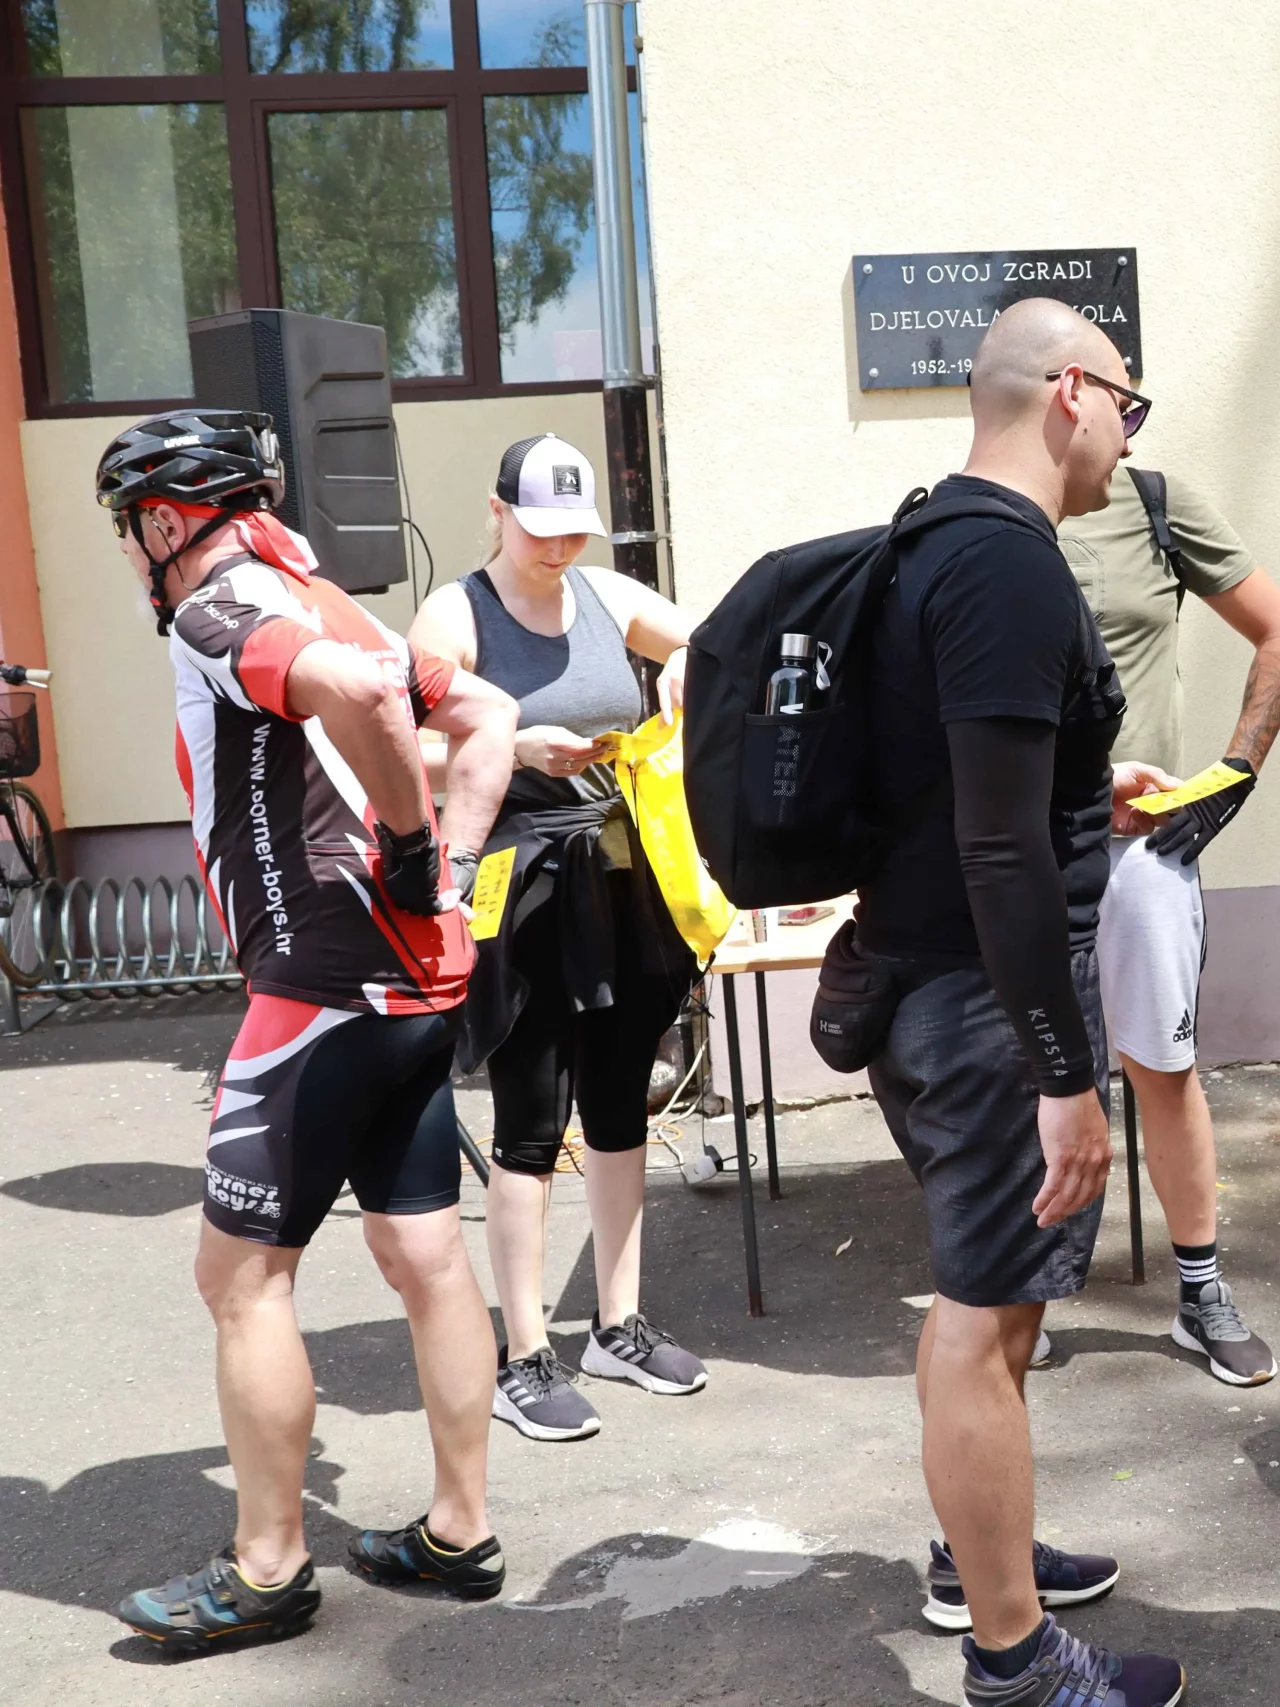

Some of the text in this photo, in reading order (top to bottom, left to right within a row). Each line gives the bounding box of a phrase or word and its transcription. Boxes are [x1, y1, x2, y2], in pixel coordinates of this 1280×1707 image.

[901, 260, 1093, 284] U OVOJ ZGRADI
[1027, 1008, 1069, 1077] KIPSTA
[204, 1161, 279, 1201] Corner
[207, 1176, 258, 1211] Boys
